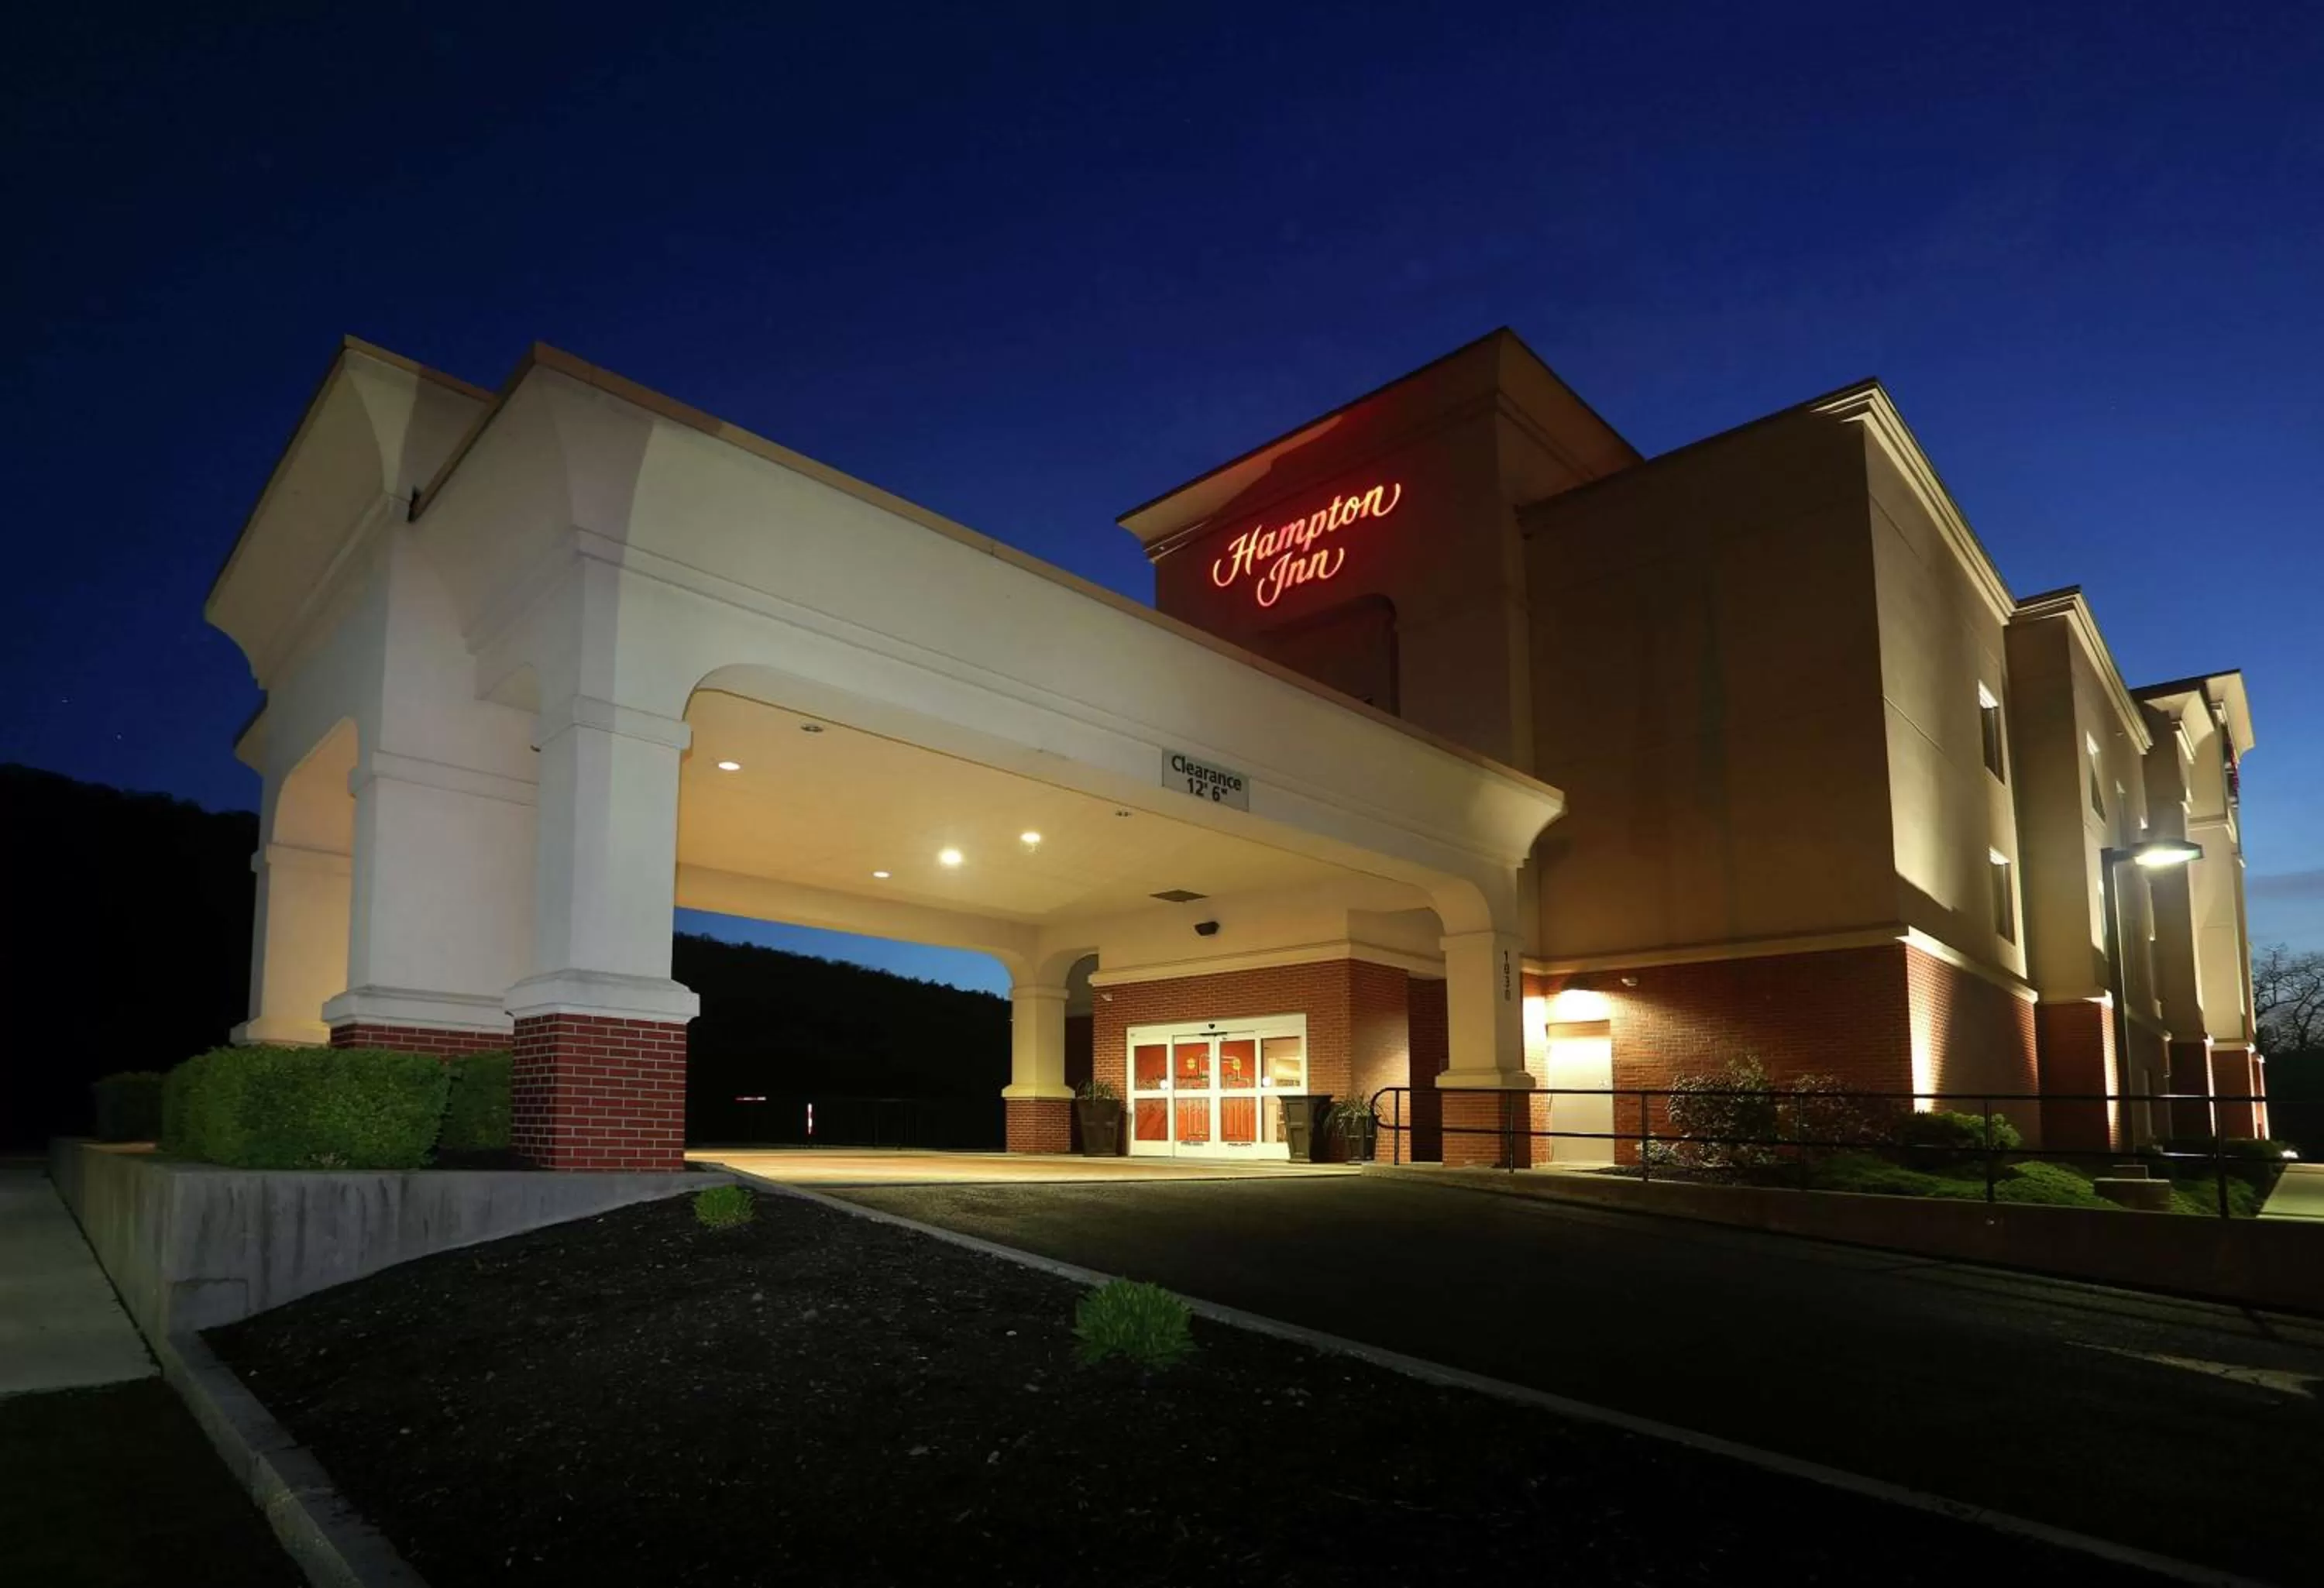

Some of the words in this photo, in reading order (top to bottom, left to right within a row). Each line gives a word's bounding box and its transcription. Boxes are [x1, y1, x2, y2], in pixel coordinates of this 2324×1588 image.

[1212, 483, 1401, 586] Hampton
[1257, 548, 1344, 607] Inn
[1171, 755, 1242, 791] Clearance
